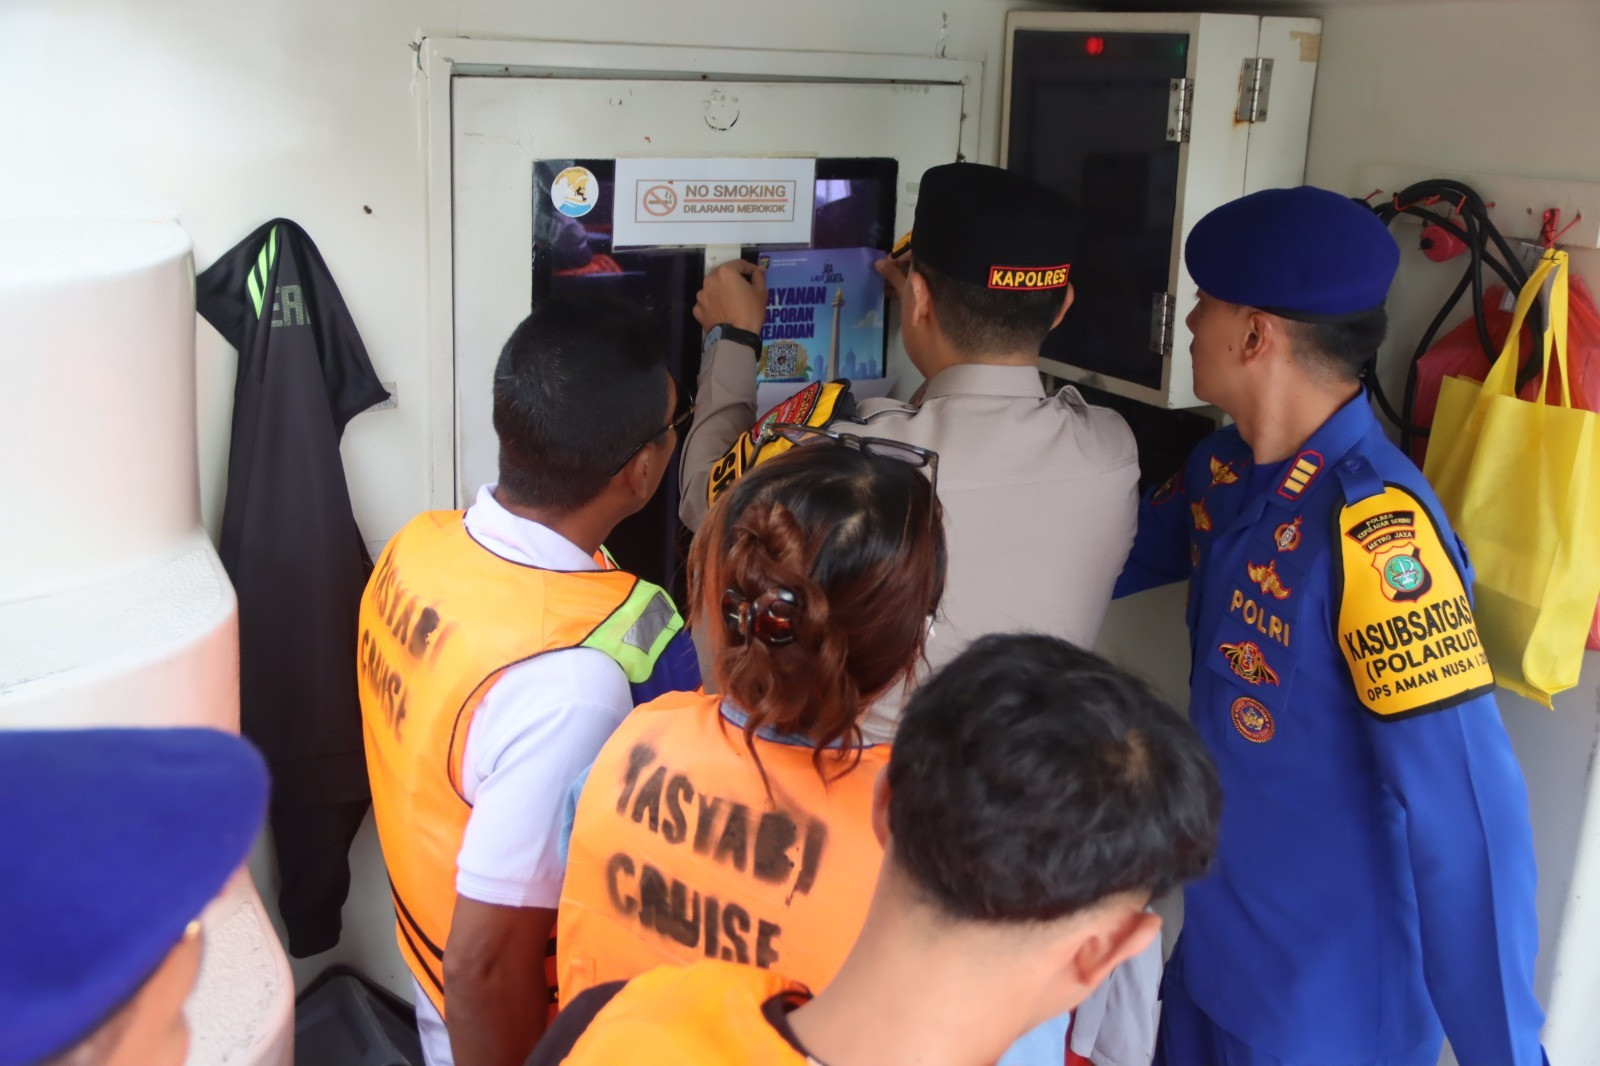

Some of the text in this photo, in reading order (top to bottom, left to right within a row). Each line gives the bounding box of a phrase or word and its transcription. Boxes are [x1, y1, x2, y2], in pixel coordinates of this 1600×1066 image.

[685, 185, 786, 198] NO SMOKING
[683, 204, 786, 214] DILARANG MEROKOK
[992, 268, 1067, 287] KAPOLRES
[767, 286, 827, 305] AYANAN
[764, 307, 814, 323] APORAN
[1367, 534, 1391, 550] METRO
[1230, 589, 1290, 647] POLRI
[1344, 595, 1472, 662] KASUBSATGAS
[1367, 684, 1392, 701] OPS
[1395, 669, 1439, 694] AMAN
[1440, 657, 1475, 679] NUSA
